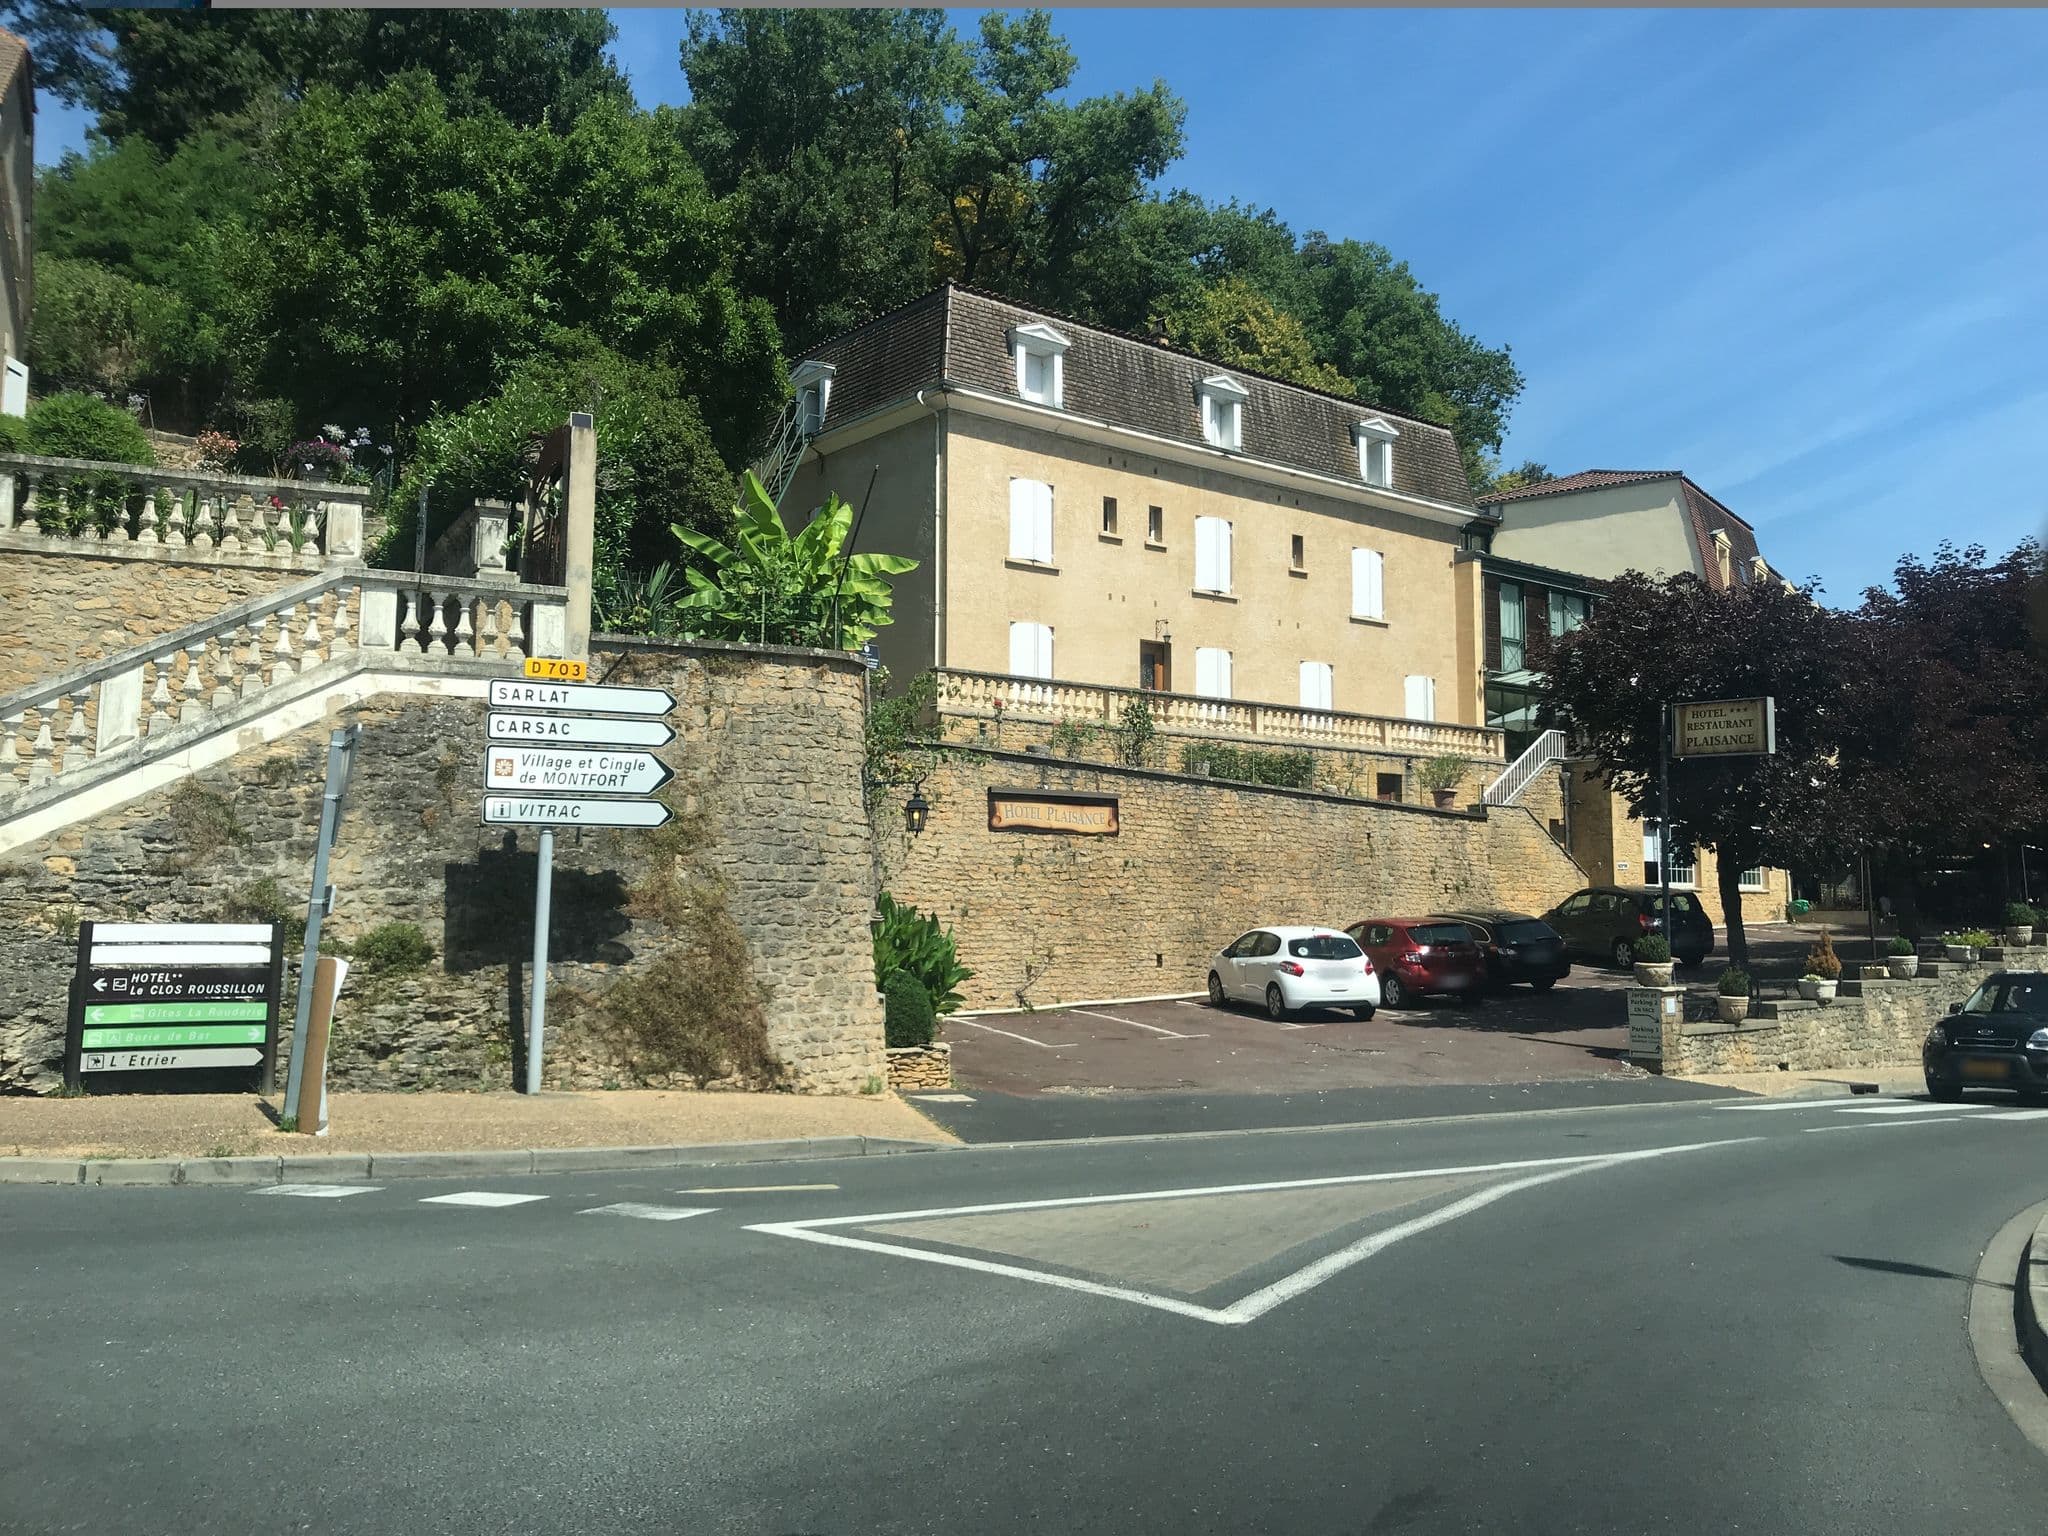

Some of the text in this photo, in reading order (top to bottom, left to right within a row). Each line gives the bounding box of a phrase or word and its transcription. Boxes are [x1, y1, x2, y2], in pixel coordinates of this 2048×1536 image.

[532, 661, 581, 677] D 703
[498, 687, 569, 704] SARLAT
[1691, 708, 1727, 719] HOTEL
[496, 719, 571, 735] CARSAC
[1687, 719, 1754, 731] RESTAURANT
[1686, 733, 1755, 748] PLAISANCE
[521, 753, 646, 774] Village et Cingle
[519, 771, 628, 787] de MONTFORT
[519, 803, 581, 818] VITRAC
[1004, 804, 1106, 825] HOTEL PLAISANCE
[129, 983, 265, 996] Le CLOS ROUSSILLON
[1630, 999, 1653, 1007] Parking
[1631, 1026, 1654, 1034] Parking
